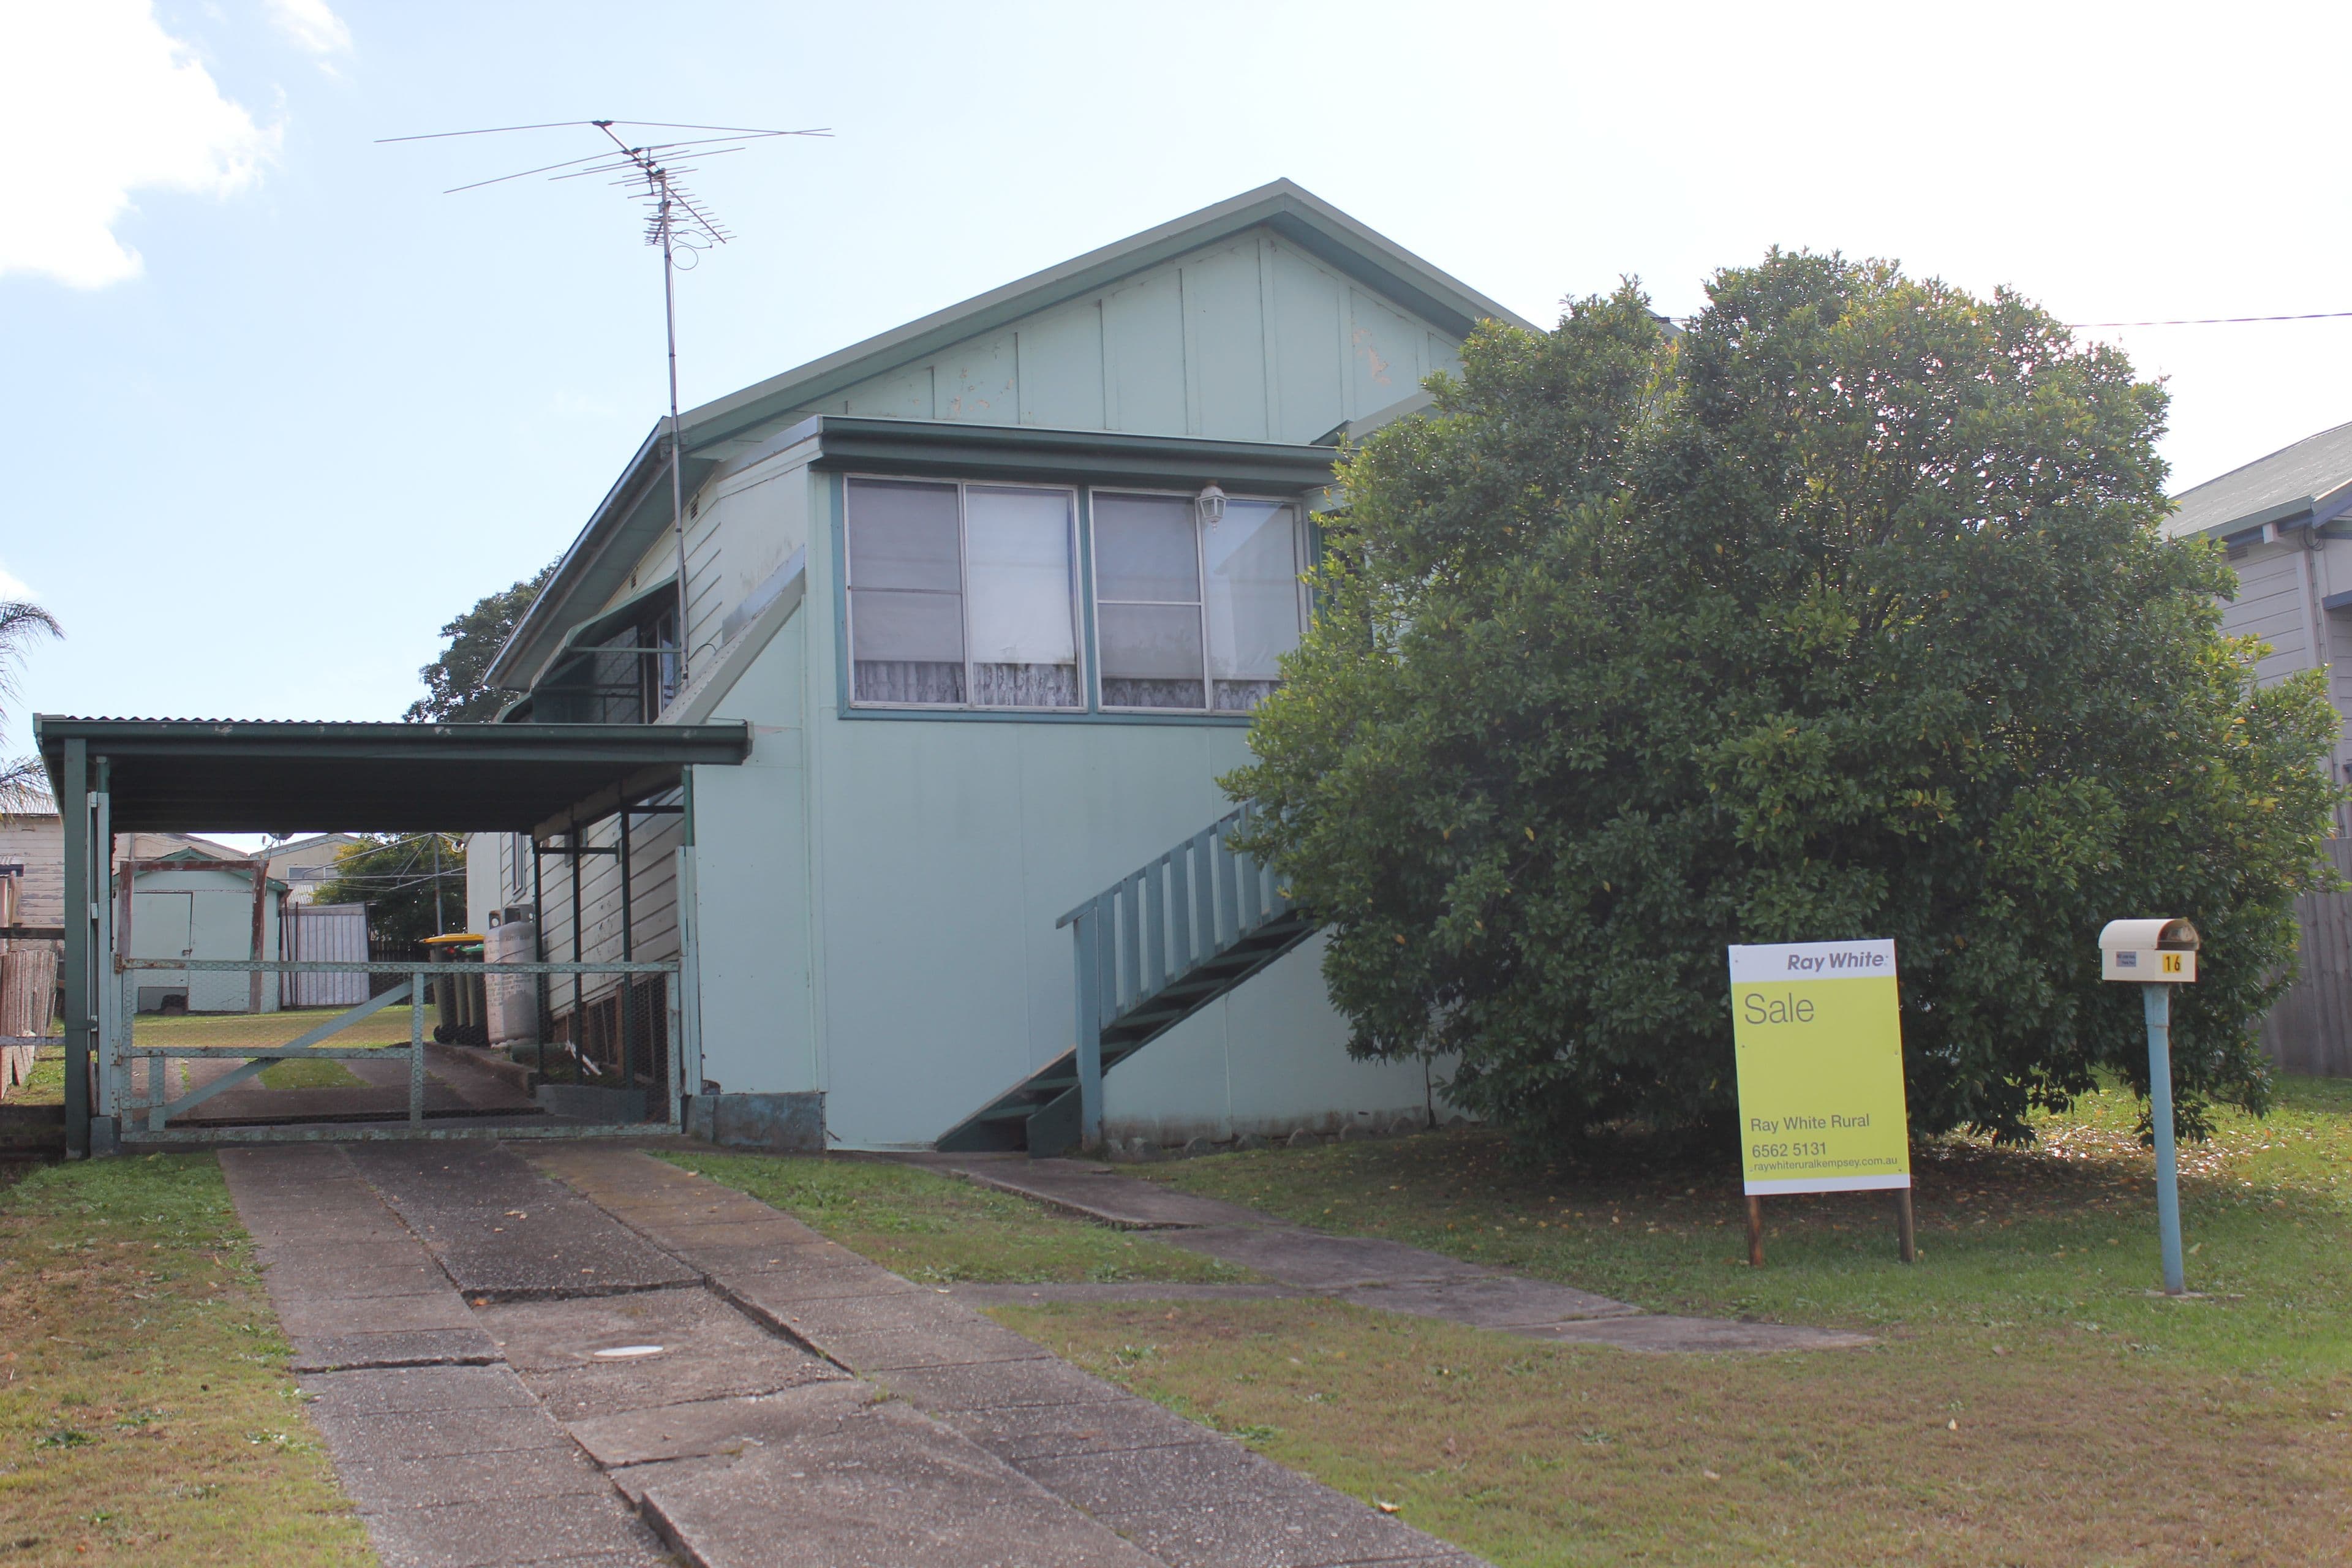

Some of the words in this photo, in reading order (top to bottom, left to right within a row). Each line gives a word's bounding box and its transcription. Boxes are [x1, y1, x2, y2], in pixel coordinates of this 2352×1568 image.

[1787, 954, 1825, 973] Ray
[1829, 951, 1884, 968] White
[2165, 956, 2180, 971] 16
[1744, 992, 1814, 1024] Sale
[1751, 1118, 1779, 1134] Ray
[1783, 1115, 1826, 1130] White
[1831, 1114, 1870, 1128] Rural
[1752, 1144, 1788, 1158] 6562
[1793, 1142, 1826, 1156] 5131
[1754, 1156, 1898, 1172] raywhiteruralkempsey.com.au
